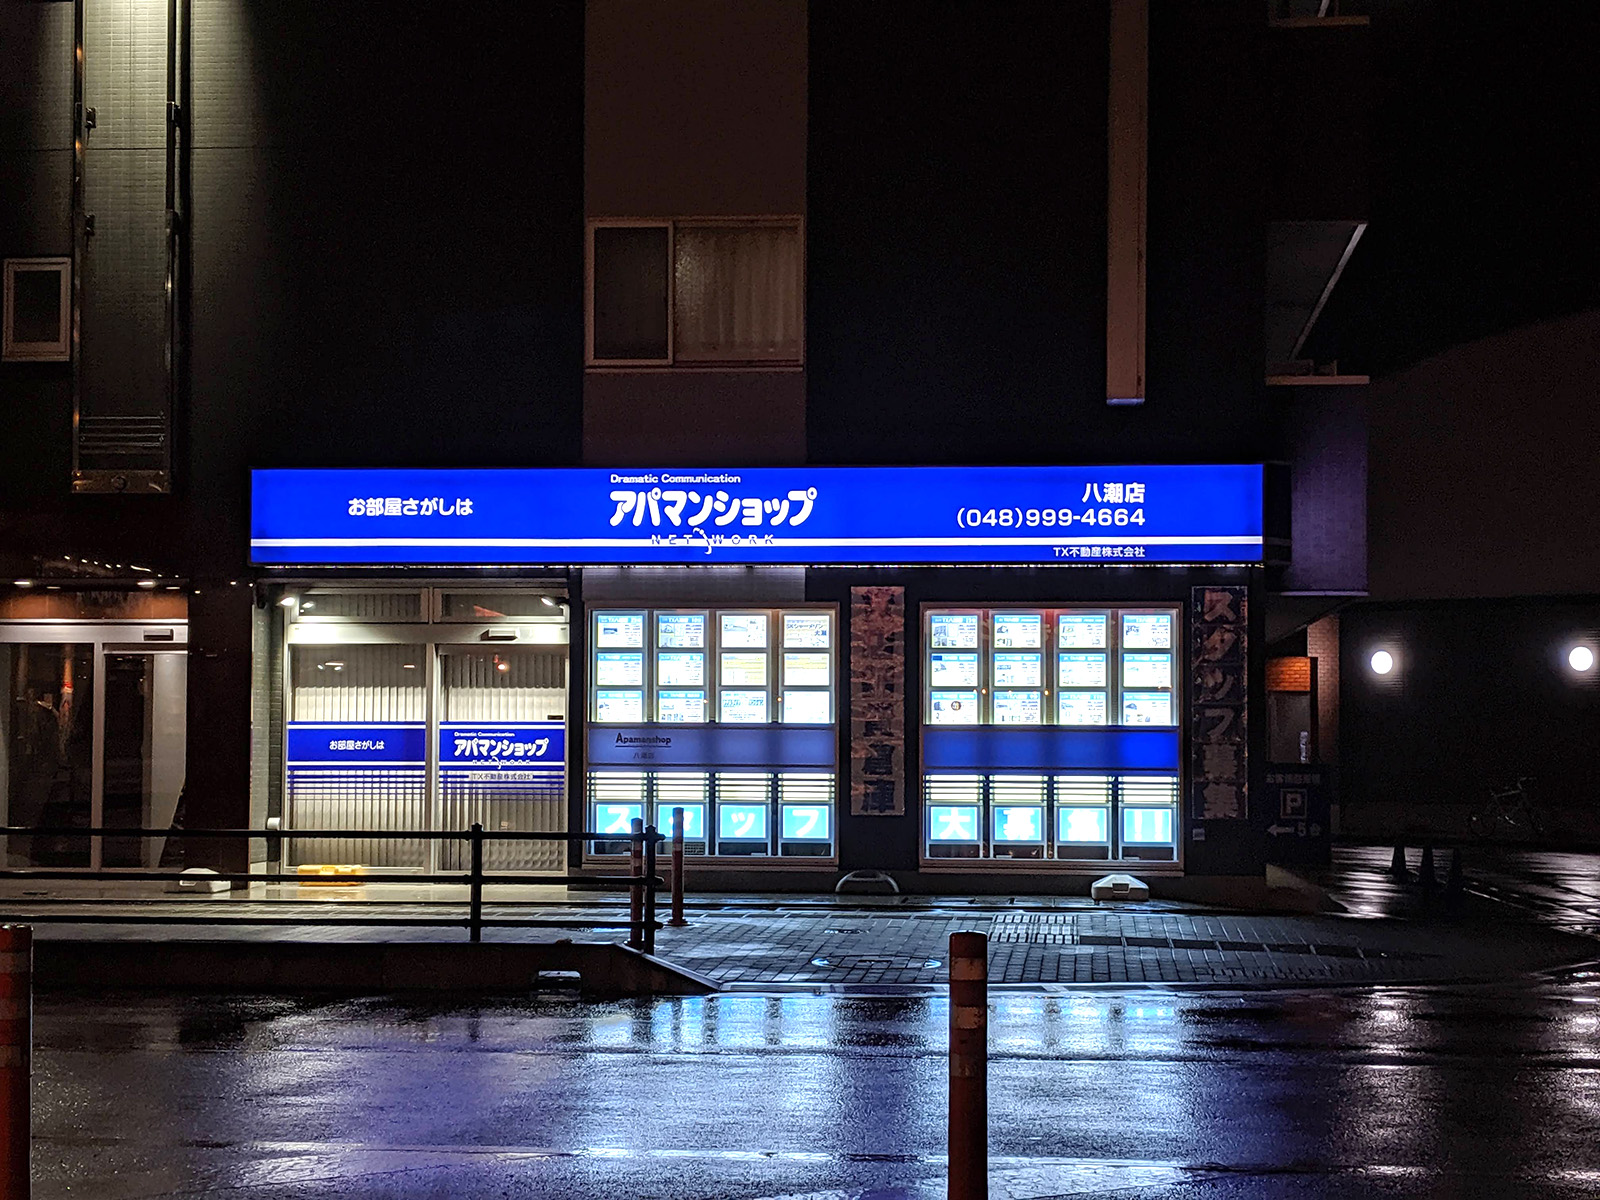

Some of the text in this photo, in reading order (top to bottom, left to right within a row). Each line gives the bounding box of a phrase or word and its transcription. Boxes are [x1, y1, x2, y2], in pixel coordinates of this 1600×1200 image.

[610, 473, 741, 484] Dramatic Communication
[1082, 482, 1146, 504] 八潮店
[348, 497, 474, 517] お部屋さがしは
[608, 487, 818, 527] アパマンショップ
[956, 507, 1146, 529] (048)999-4664
[1053, 546, 1146, 558] TX不動産株式会社
[329, 740, 385, 751] お部屋さがしは
[453, 737, 549, 757] アパマンショップ
[615, 732, 672, 746] Apamanshop
